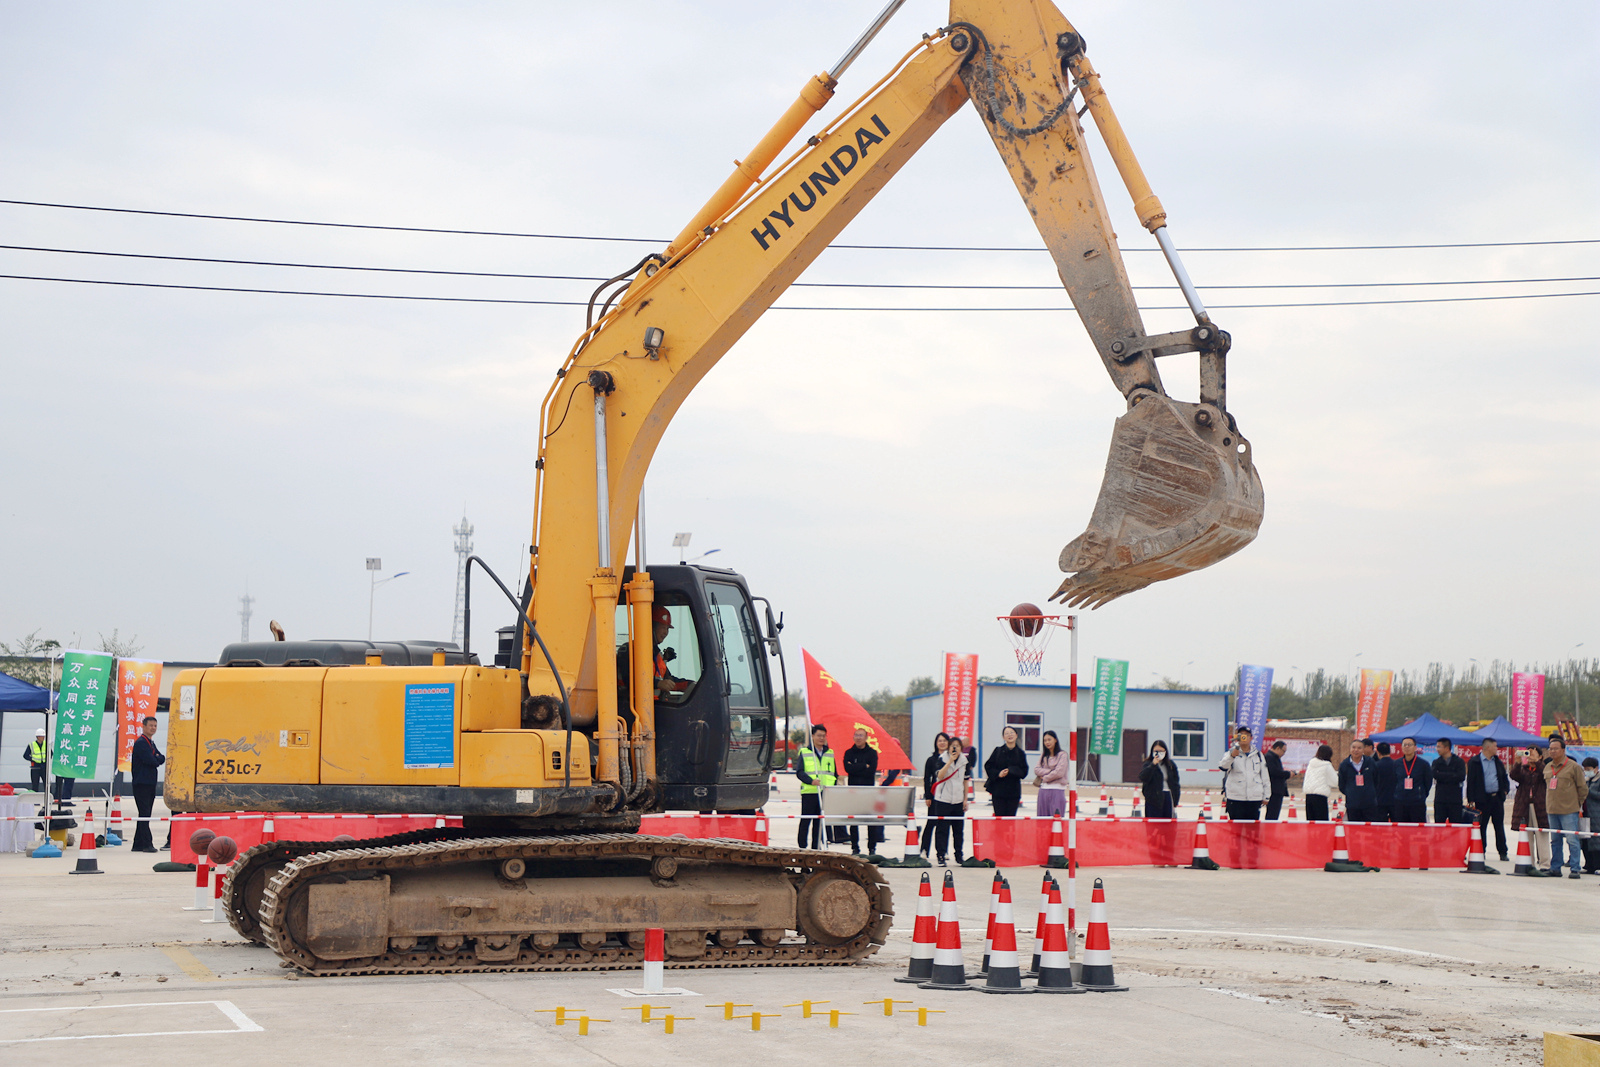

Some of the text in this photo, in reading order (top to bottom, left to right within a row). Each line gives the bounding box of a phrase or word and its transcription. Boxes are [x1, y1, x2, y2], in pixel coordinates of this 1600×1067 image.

[751, 113, 891, 251] HYUNDAI
[59, 662, 84, 766] 万众同心赢此杯
[75, 667, 102, 768] 一技在手护千里
